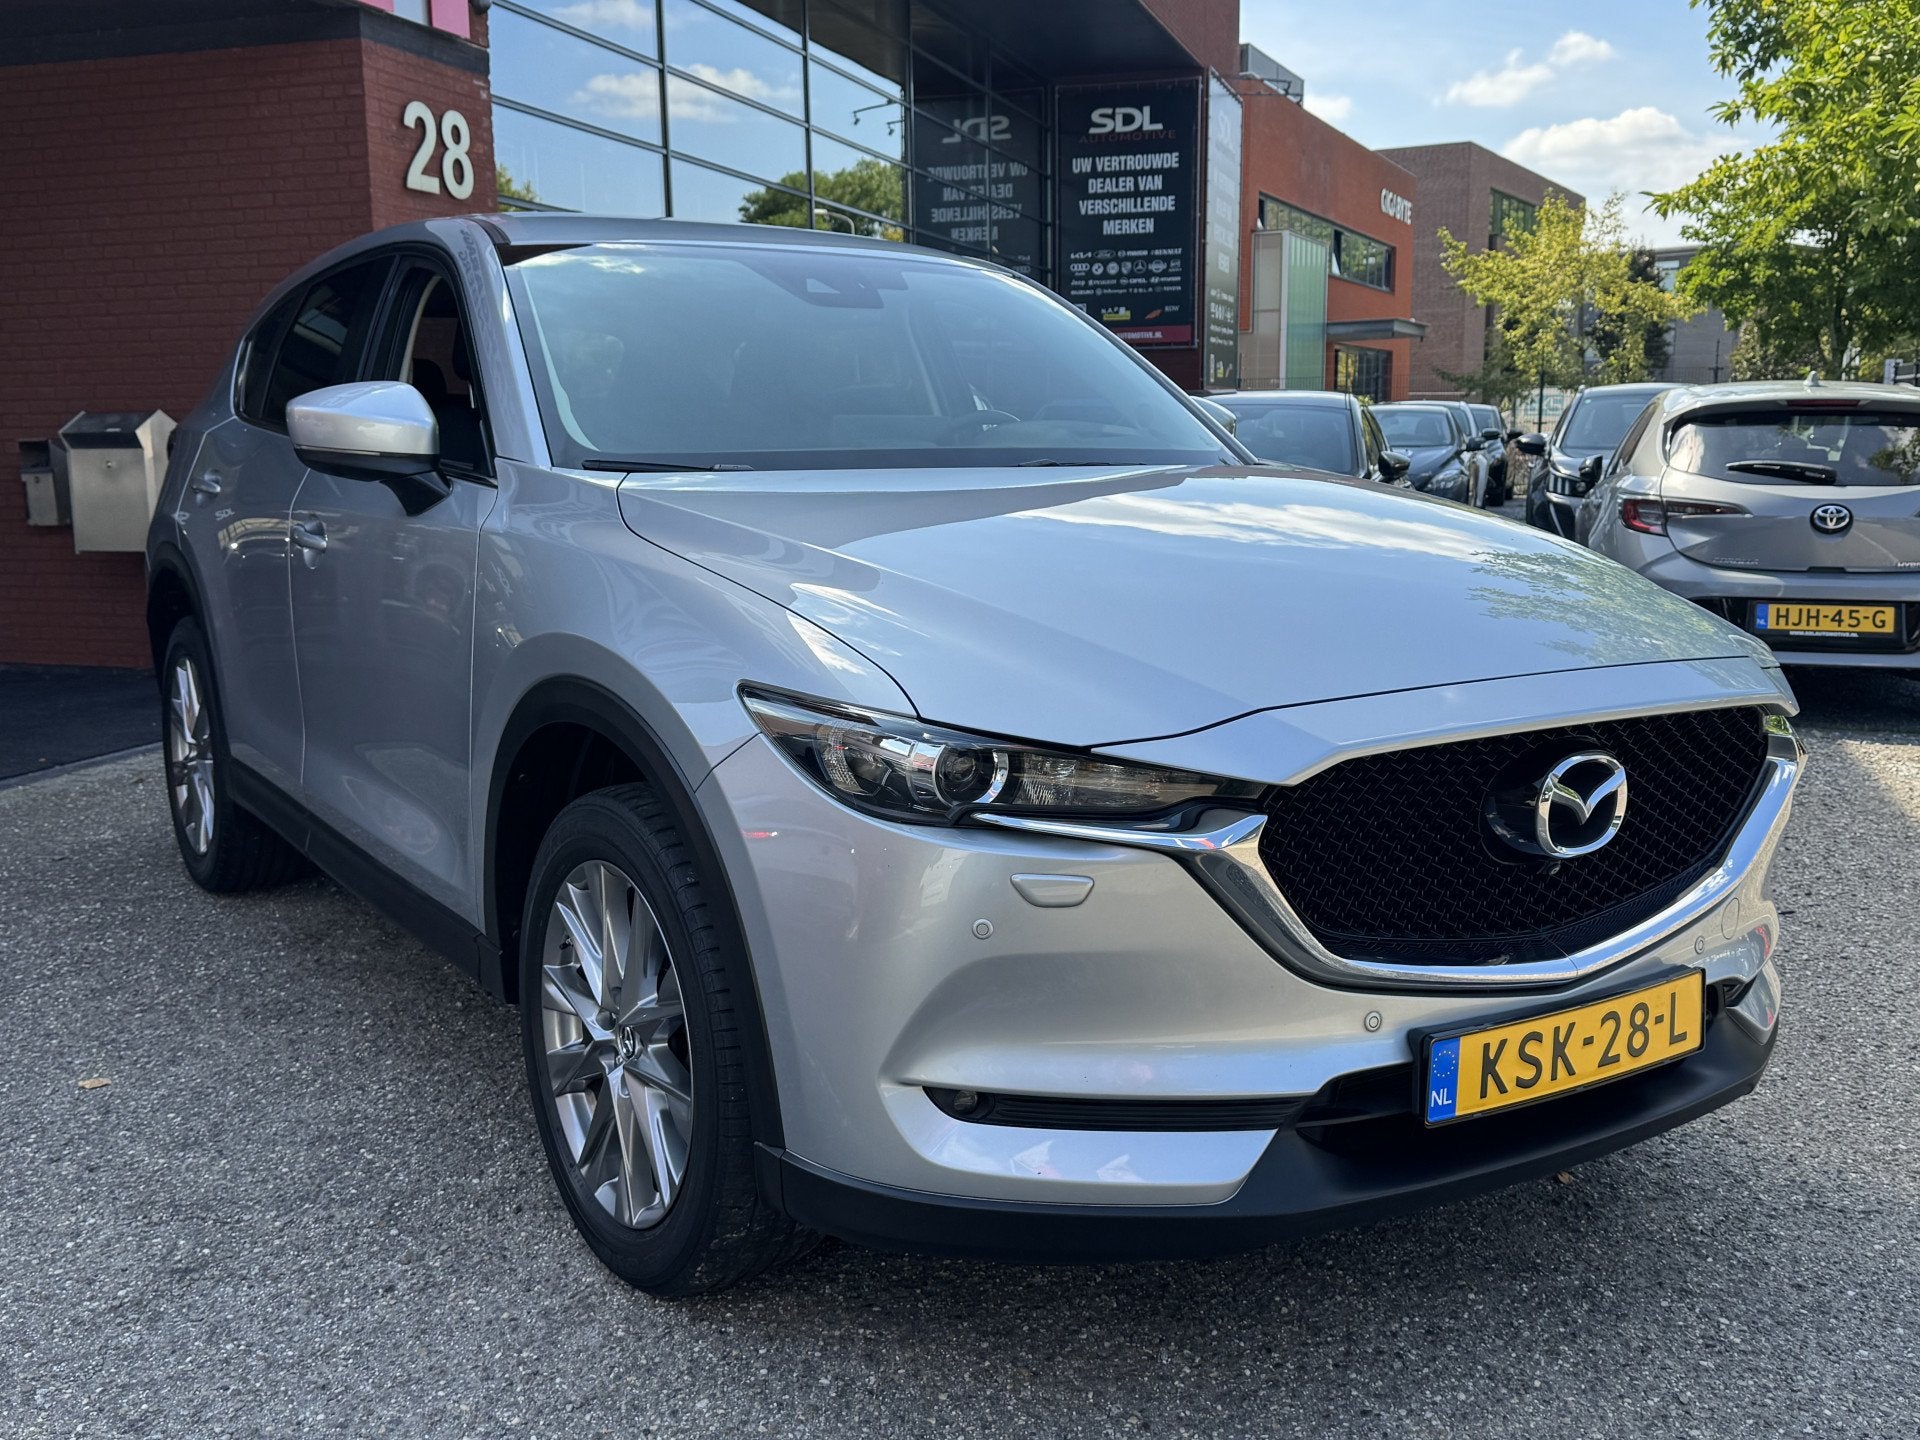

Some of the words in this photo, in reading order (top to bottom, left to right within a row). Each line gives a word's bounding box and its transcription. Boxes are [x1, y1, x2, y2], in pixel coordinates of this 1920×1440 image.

[1089, 105, 1164, 134] SDL
[1079, 130, 1177, 143] AUTOMOTIVE
[404, 100, 475, 200] 28
[1072, 157, 1092, 173] UW
[1095, 152, 1180, 172] VERTROUWDE
[1088, 176, 1135, 193] DEALER
[1138, 174, 1163, 191] VAN
[1079, 195, 1176, 215] VERSCHILLENDE
[1103, 217, 1155, 235] MERKEN
[1775, 607, 1887, 629] HJH-45-G
[1430, 1087, 1452, 1108] NL
[1480, 991, 1688, 1100] KSK-28-L
